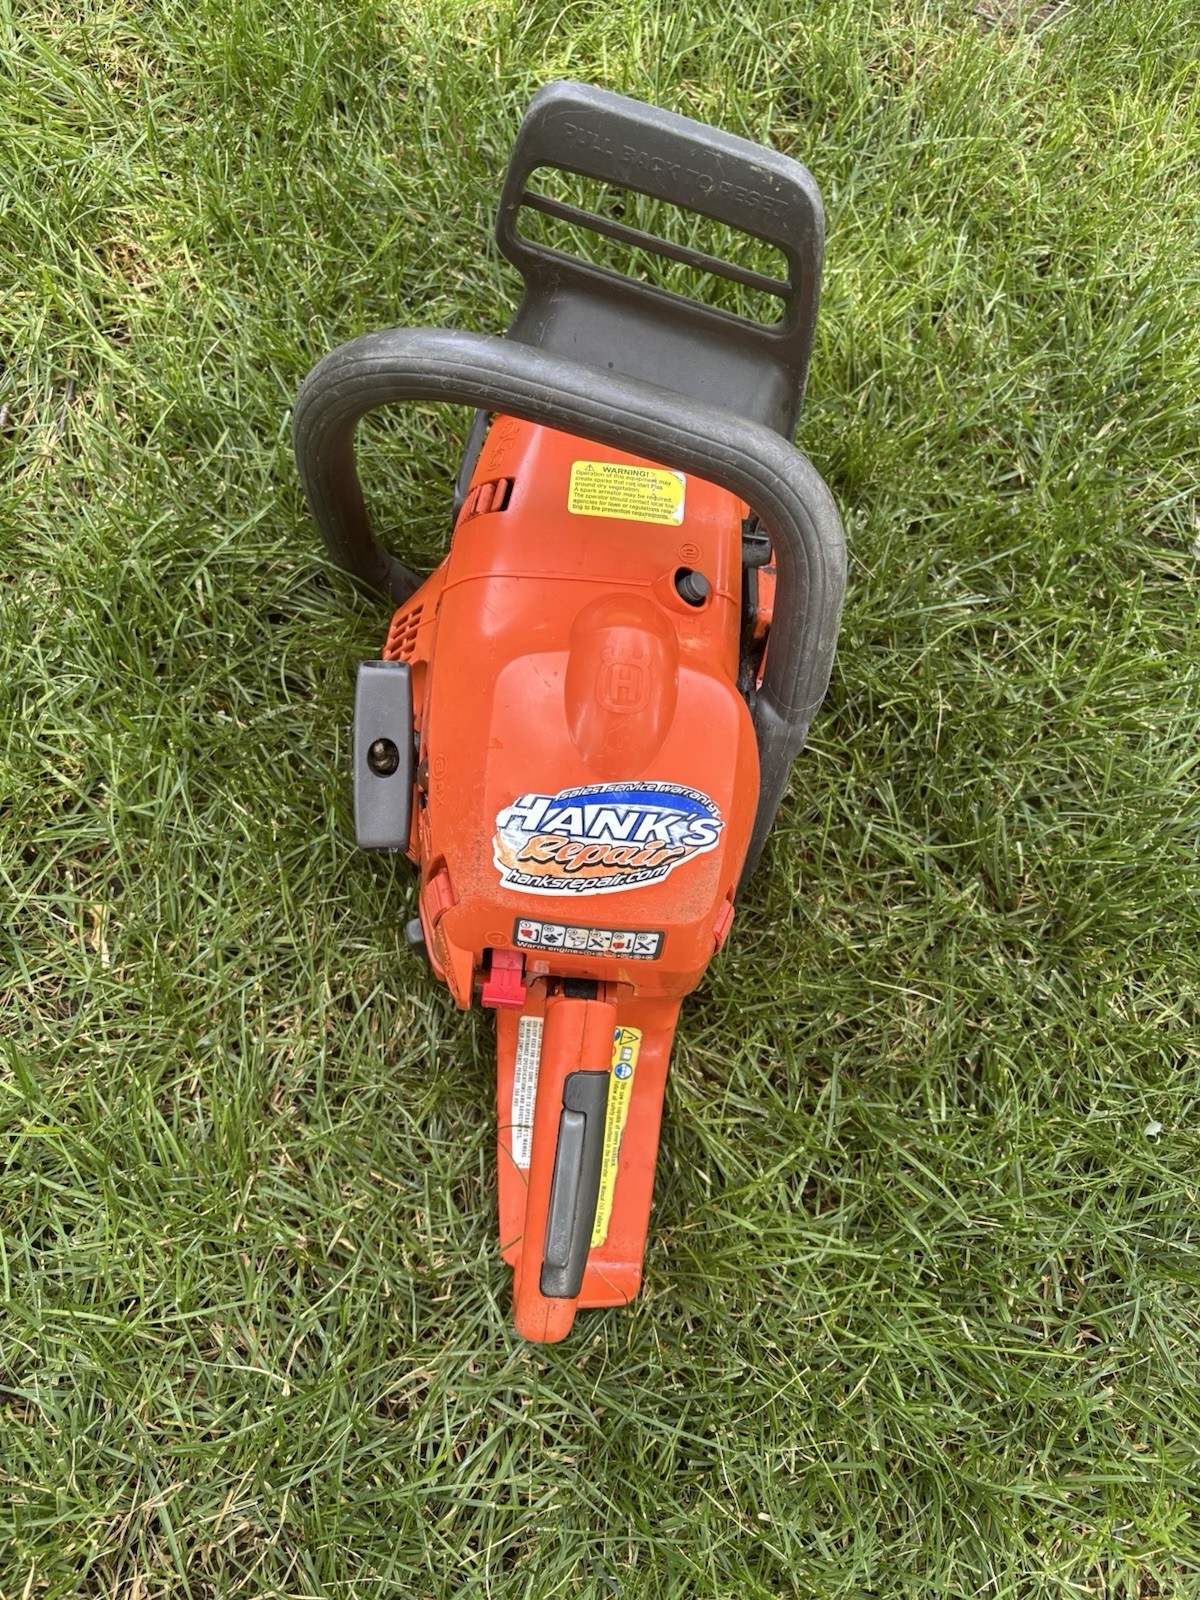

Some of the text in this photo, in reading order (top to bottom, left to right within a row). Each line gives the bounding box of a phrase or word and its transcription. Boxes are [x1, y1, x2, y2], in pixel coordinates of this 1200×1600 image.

[561, 122, 789, 217] PULL BACK TO RESET
[575, 469, 605, 478] Operation
[658, 479, 672, 487] may
[602, 466, 649, 478] WARNING!
[593, 477, 612, 485] sparks
[608, 484, 640, 493] vegetation.
[585, 493, 609, 501] operator
[609, 495, 628, 503] should
[650, 500, 664, 508] local
[598, 489, 622, 497] arrestor
[646, 493, 673, 503] required.
[573, 498, 598, 506] agencies
[629, 504, 660, 513] regulations
[601, 506, 631, 515] prevention
[559, 782, 721, 815] sales service warranty
[498, 796, 724, 847] HANK'S
[516, 833, 686, 873] Repair
[505, 865, 671, 892] hanksrepair.com
[517, 941, 546, 951] Warm
[520, 1057, 529, 1093] SPECIFICATIONS
[606, 1116, 615, 1143] precautions
